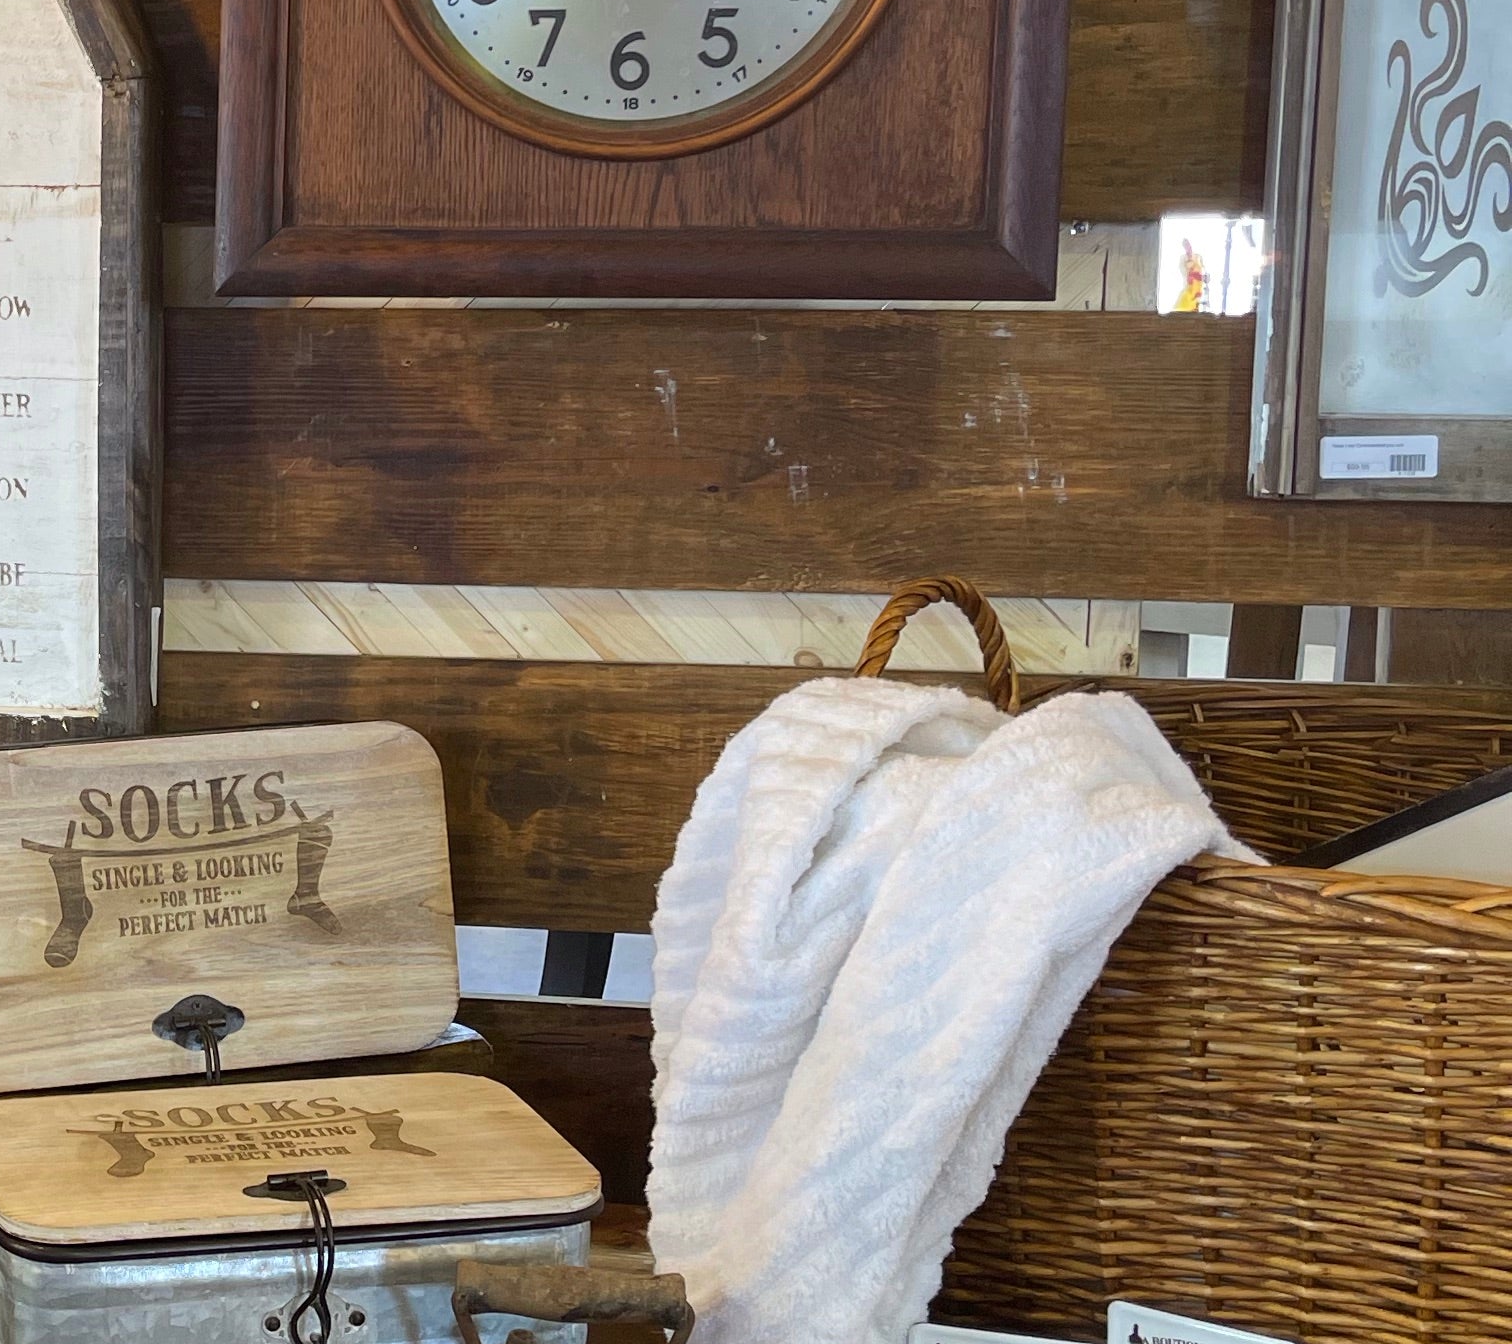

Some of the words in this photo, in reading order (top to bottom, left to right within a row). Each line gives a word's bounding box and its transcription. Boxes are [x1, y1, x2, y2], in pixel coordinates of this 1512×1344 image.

[527, 8, 568, 68] 7
[696, 7, 739, 69] 5
[516, 66, 535, 85] 19
[609, 30, 651, 91] 6
[731, 65, 749, 84] 17
[622, 96, 640, 111] 18
[78, 769, 288, 845] SOCKS
[91, 862, 166, 893] SINGLE
[171, 861, 189, 884] &
[195, 851, 285, 882] LOOKING
[117, 910, 199, 939] PERFECT
[202, 903, 268, 927] MATCH
[121, 1096, 347, 1130] SOCKS
[147, 1133, 230, 1148] SINGLE
[258, 1125, 358, 1142] LOOKING
[185, 1149, 273, 1165] PERFECT
[280, 1145, 352, 1160] MATCH
